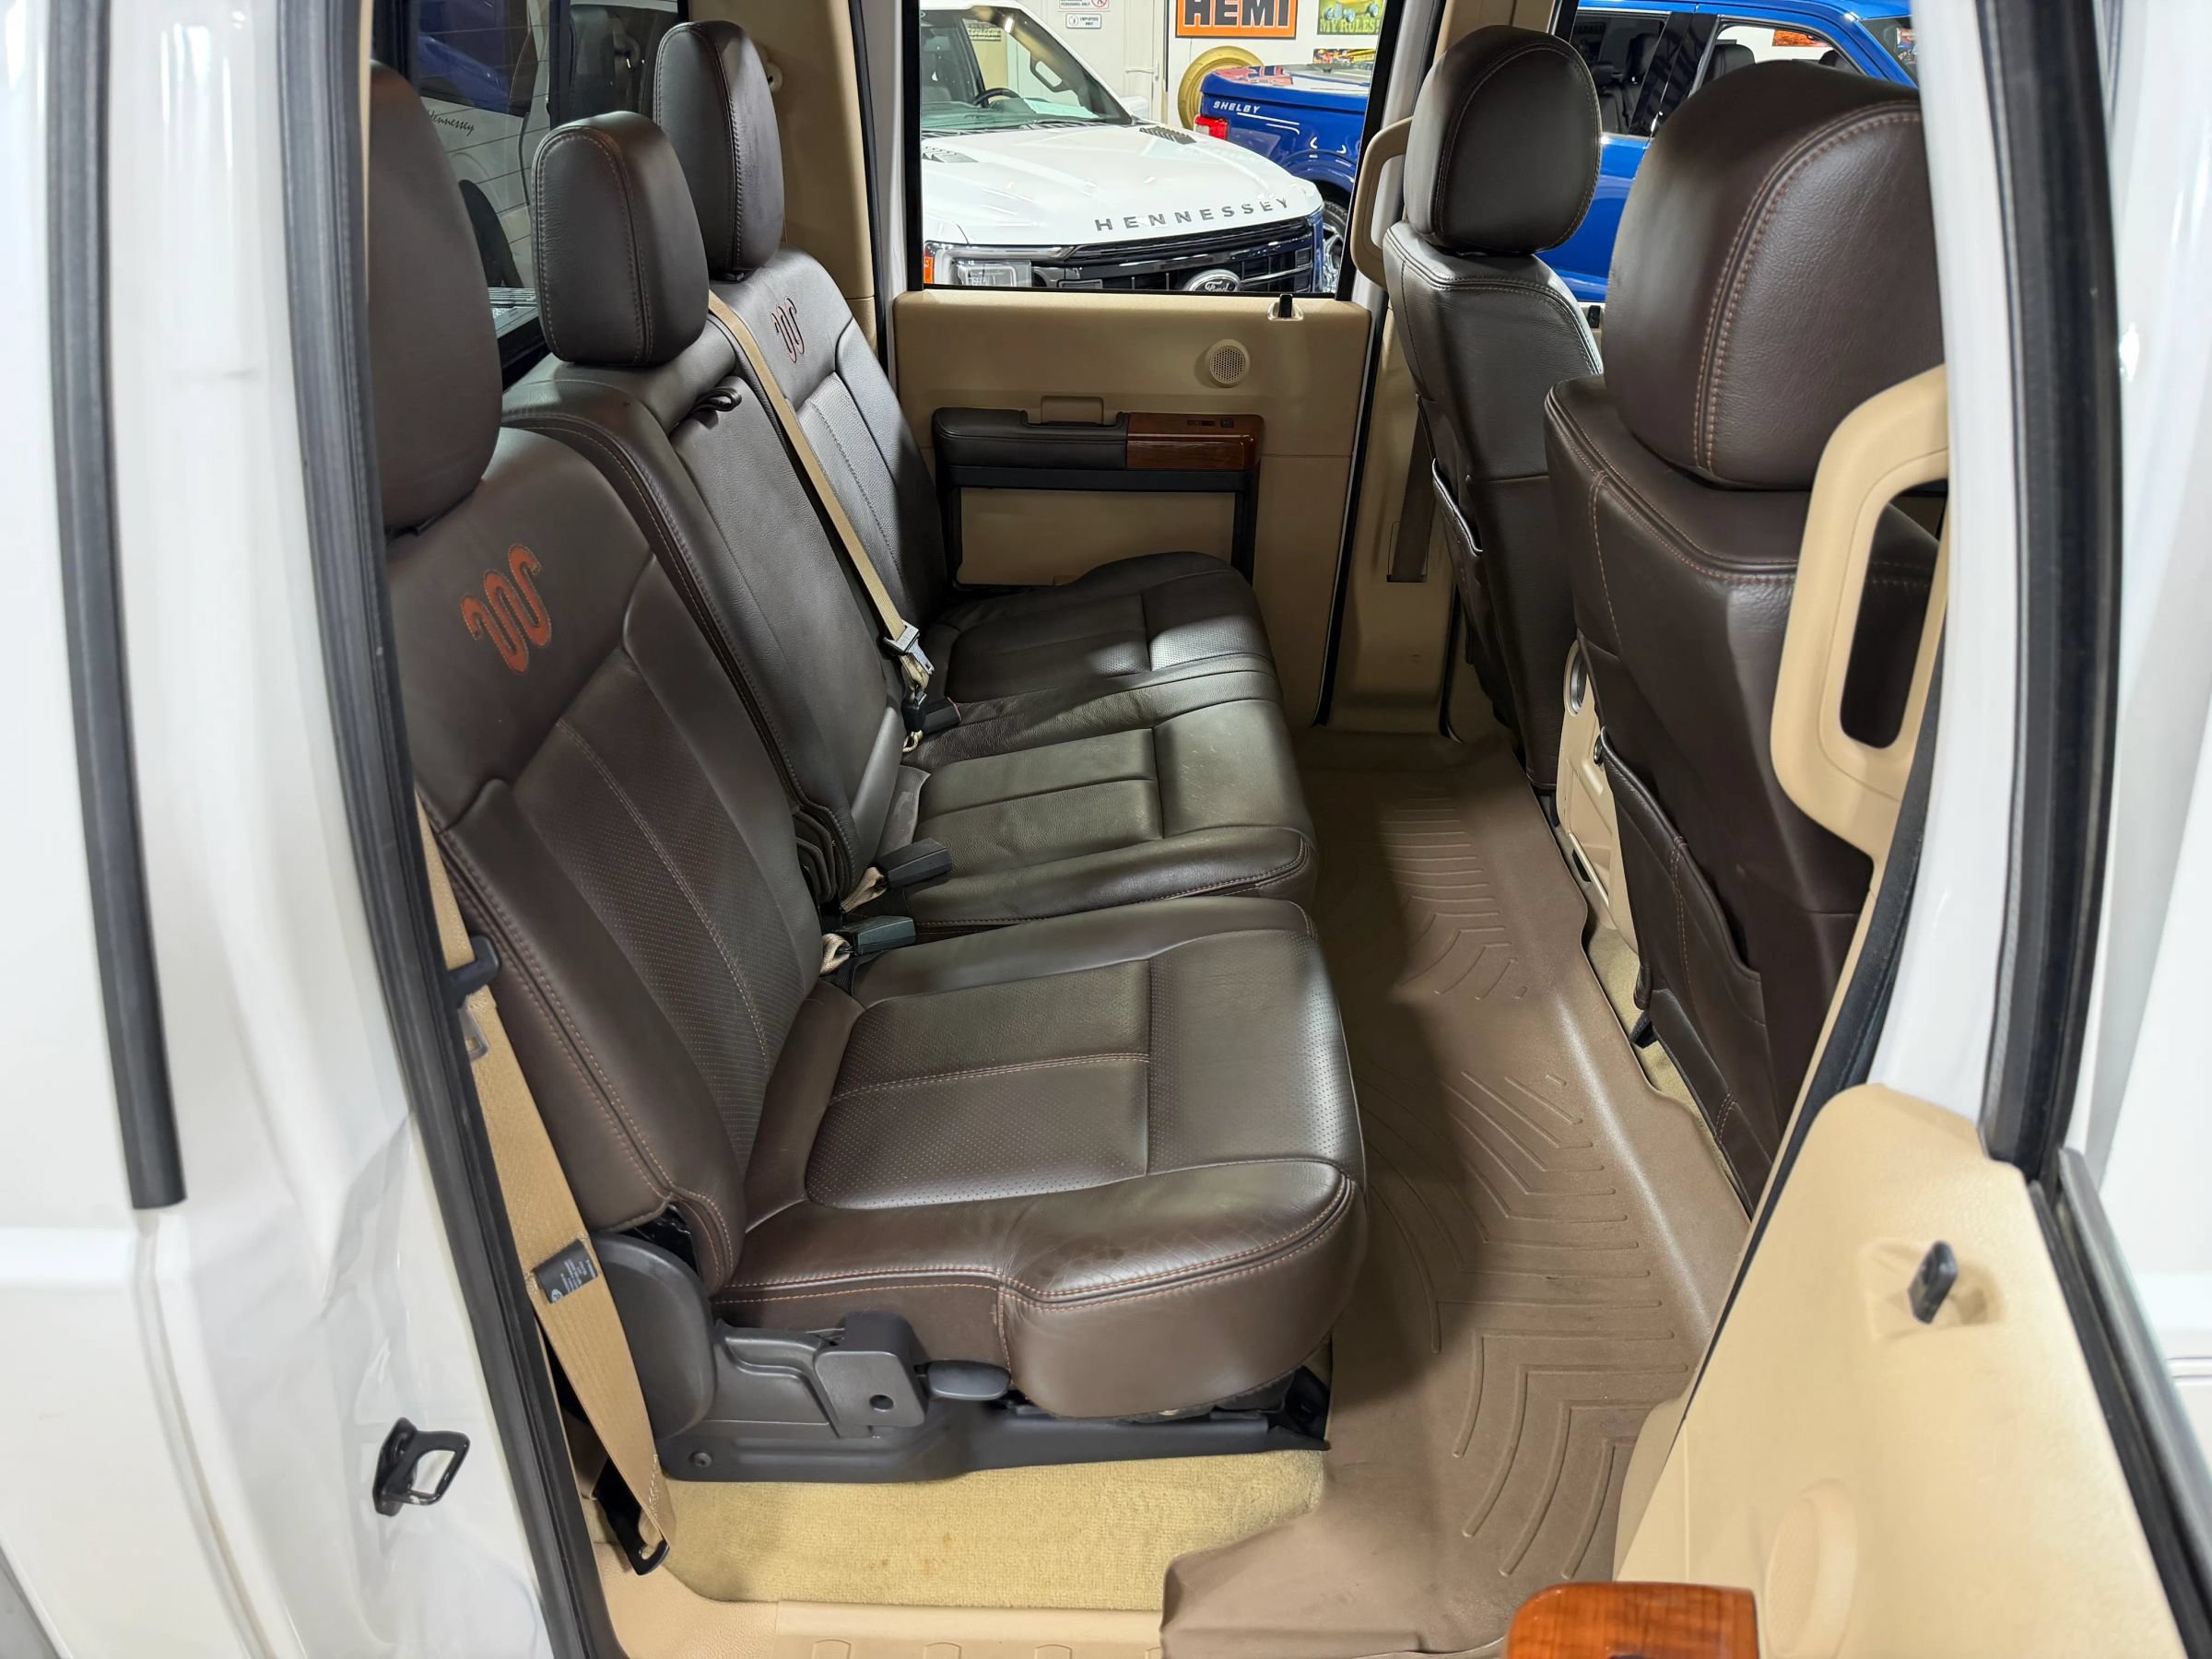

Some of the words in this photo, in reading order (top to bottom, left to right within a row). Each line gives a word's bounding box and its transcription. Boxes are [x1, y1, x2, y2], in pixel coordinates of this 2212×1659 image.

[1184, 0, 1289, 27] HEMI
[1320, 18, 1338, 32] MY
[1213, 100, 1261, 113] SHELBY
[1094, 197, 1288, 231] HENNESSEY
